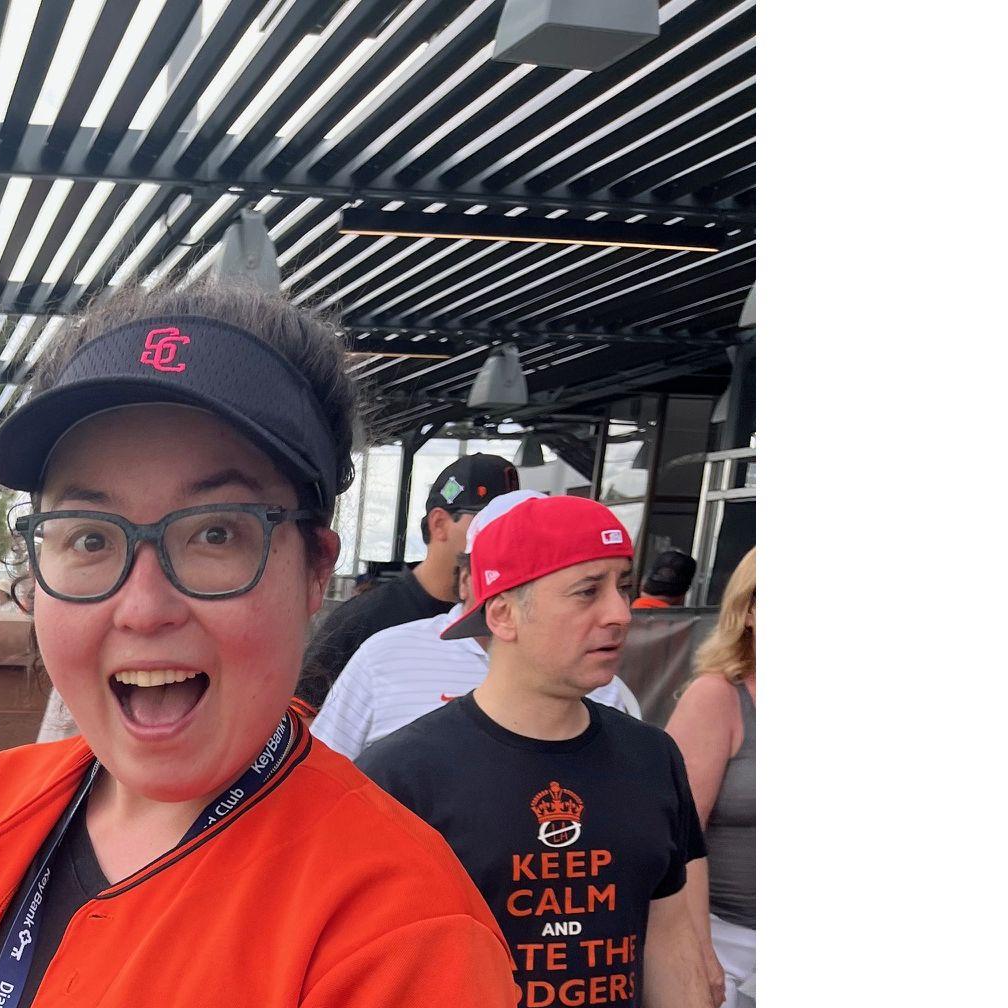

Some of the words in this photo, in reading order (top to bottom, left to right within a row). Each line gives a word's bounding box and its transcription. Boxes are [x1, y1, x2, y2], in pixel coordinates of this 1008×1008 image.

[141, 326, 191, 372] SC
[250, 718, 289, 774] KeyBank
[214, 787, 244, 817] Club
[512, 849, 612, 881] KEEP
[506, 883, 616, 917] CALM
[541, 921, 583, 936] AND
[579, 934, 637, 968] THE
